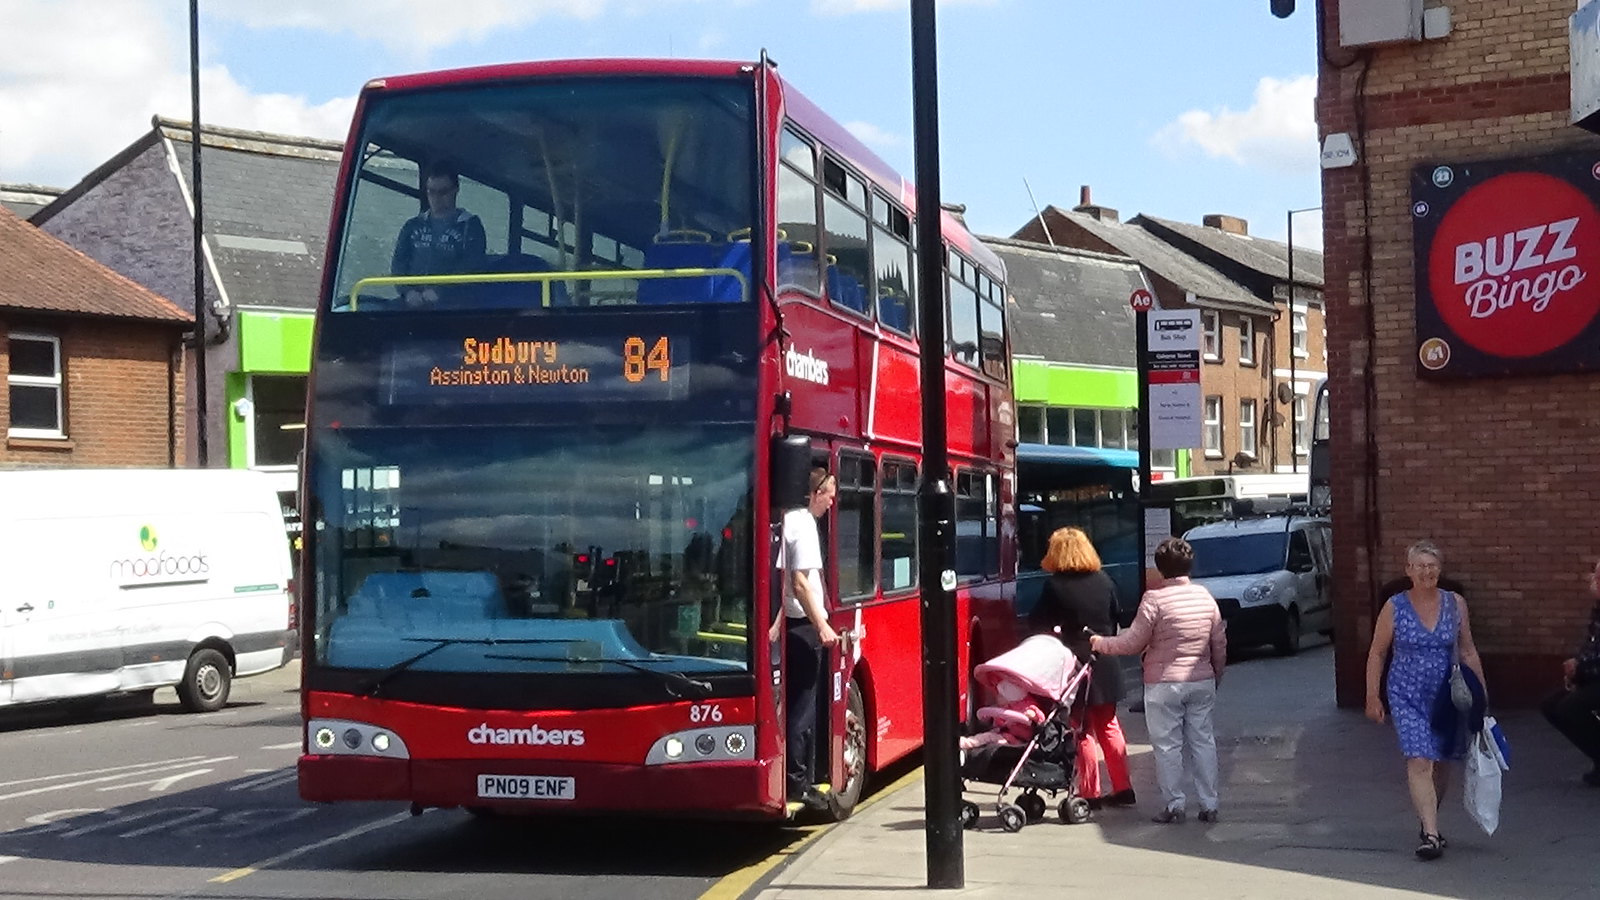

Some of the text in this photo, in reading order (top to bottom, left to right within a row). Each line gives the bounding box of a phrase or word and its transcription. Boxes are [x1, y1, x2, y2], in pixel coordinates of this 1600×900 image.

[1455, 217, 1580, 284] BUZZ
[1465, 265, 1587, 318] Bingo
[463, 337, 557, 365] Sudbury
[624, 336, 670, 382] 84
[786, 342, 829, 386] chambers
[430, 364, 589, 385] Assington & Newton
[690, 704, 723, 722] 876
[468, 723, 586, 746] chambers
[484, 778, 569, 796] PN09 ENF
